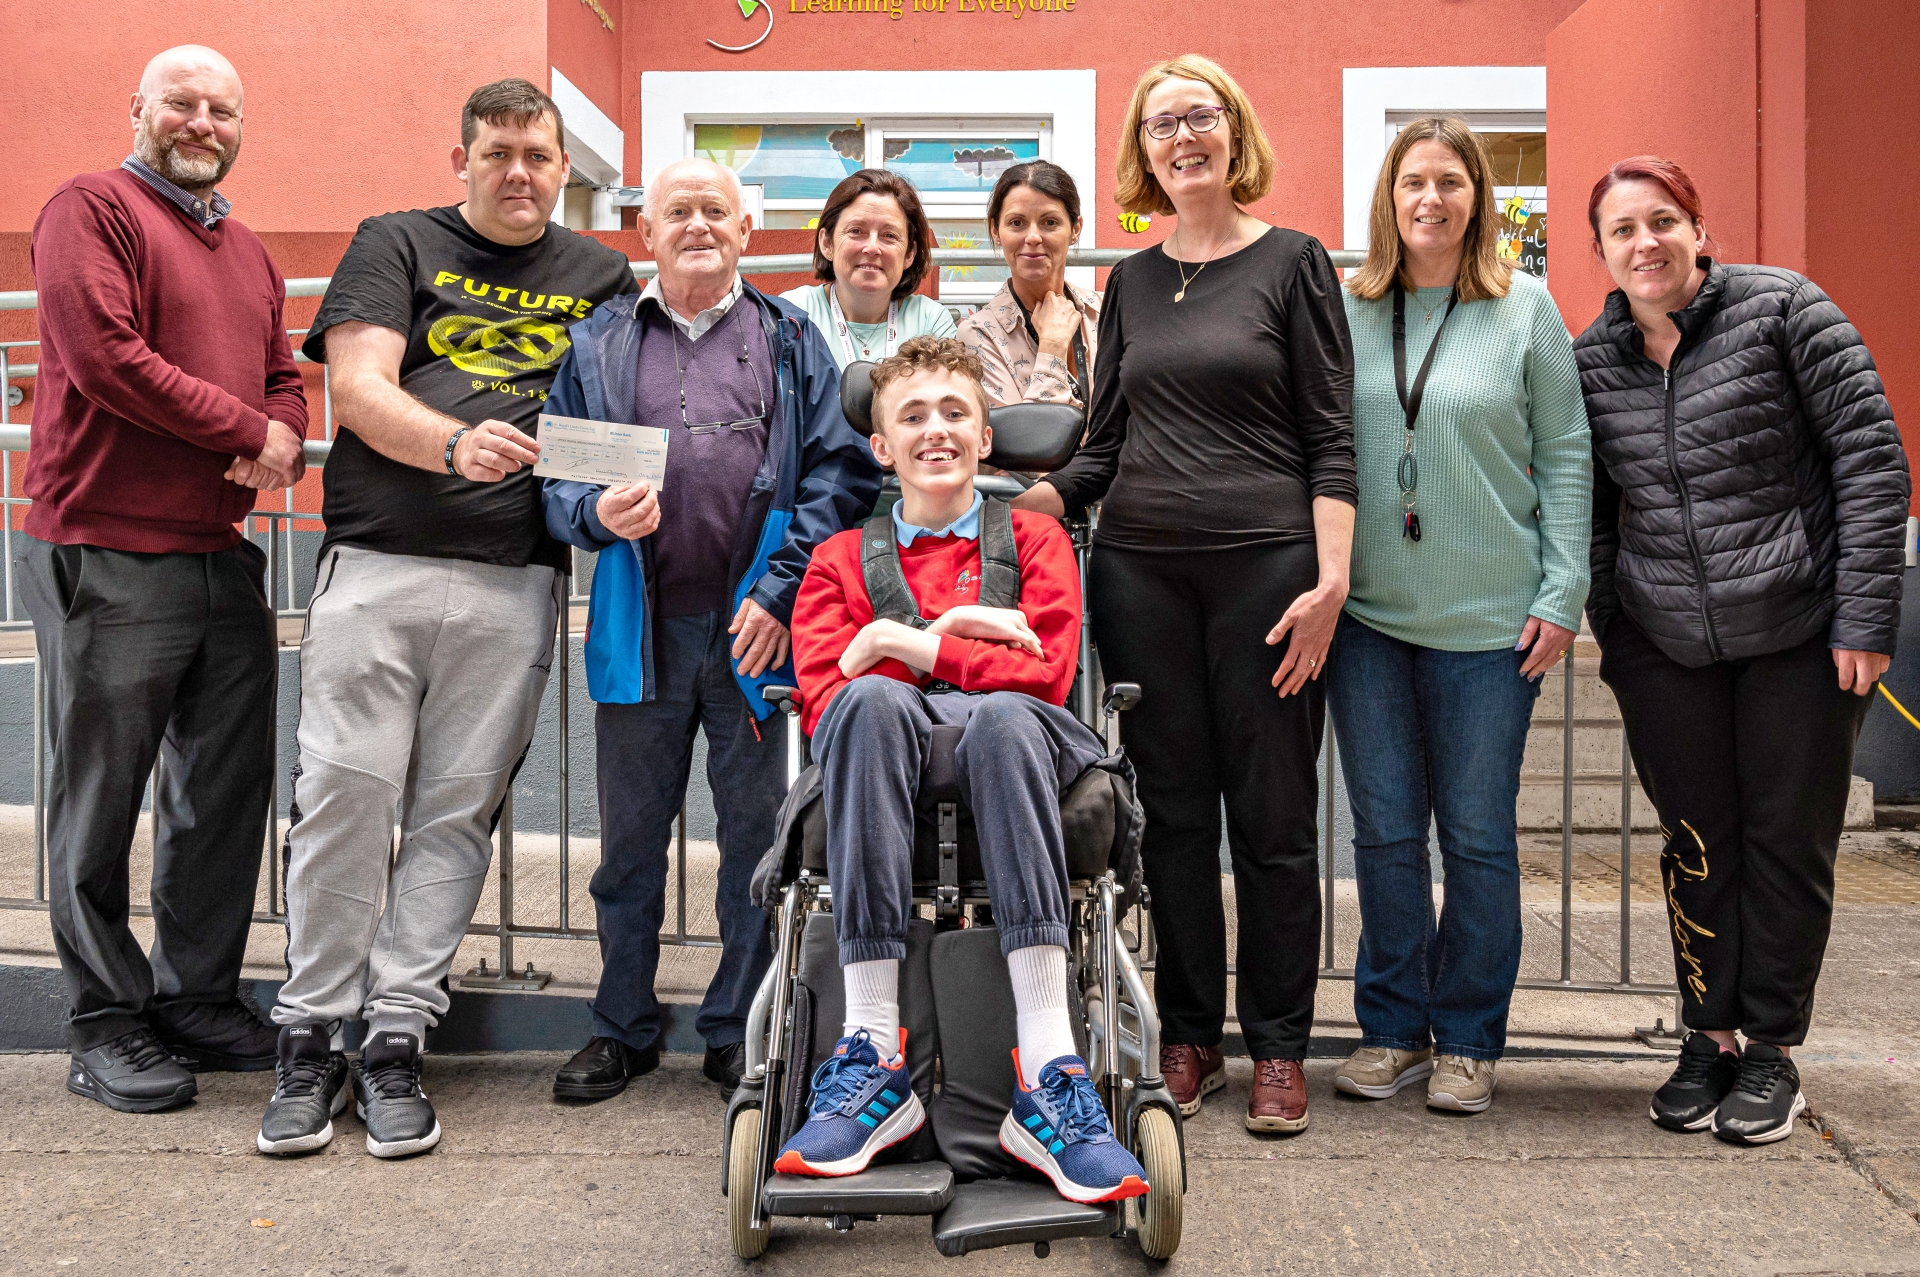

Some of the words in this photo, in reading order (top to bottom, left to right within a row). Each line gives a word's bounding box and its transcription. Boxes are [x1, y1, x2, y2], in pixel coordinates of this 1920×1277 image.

[789, 0, 903, 20] Learning
[957, 0, 1076, 19] Everyone
[434, 270, 593, 319] FUTURE
[490, 381, 535, 398] VOL.1
